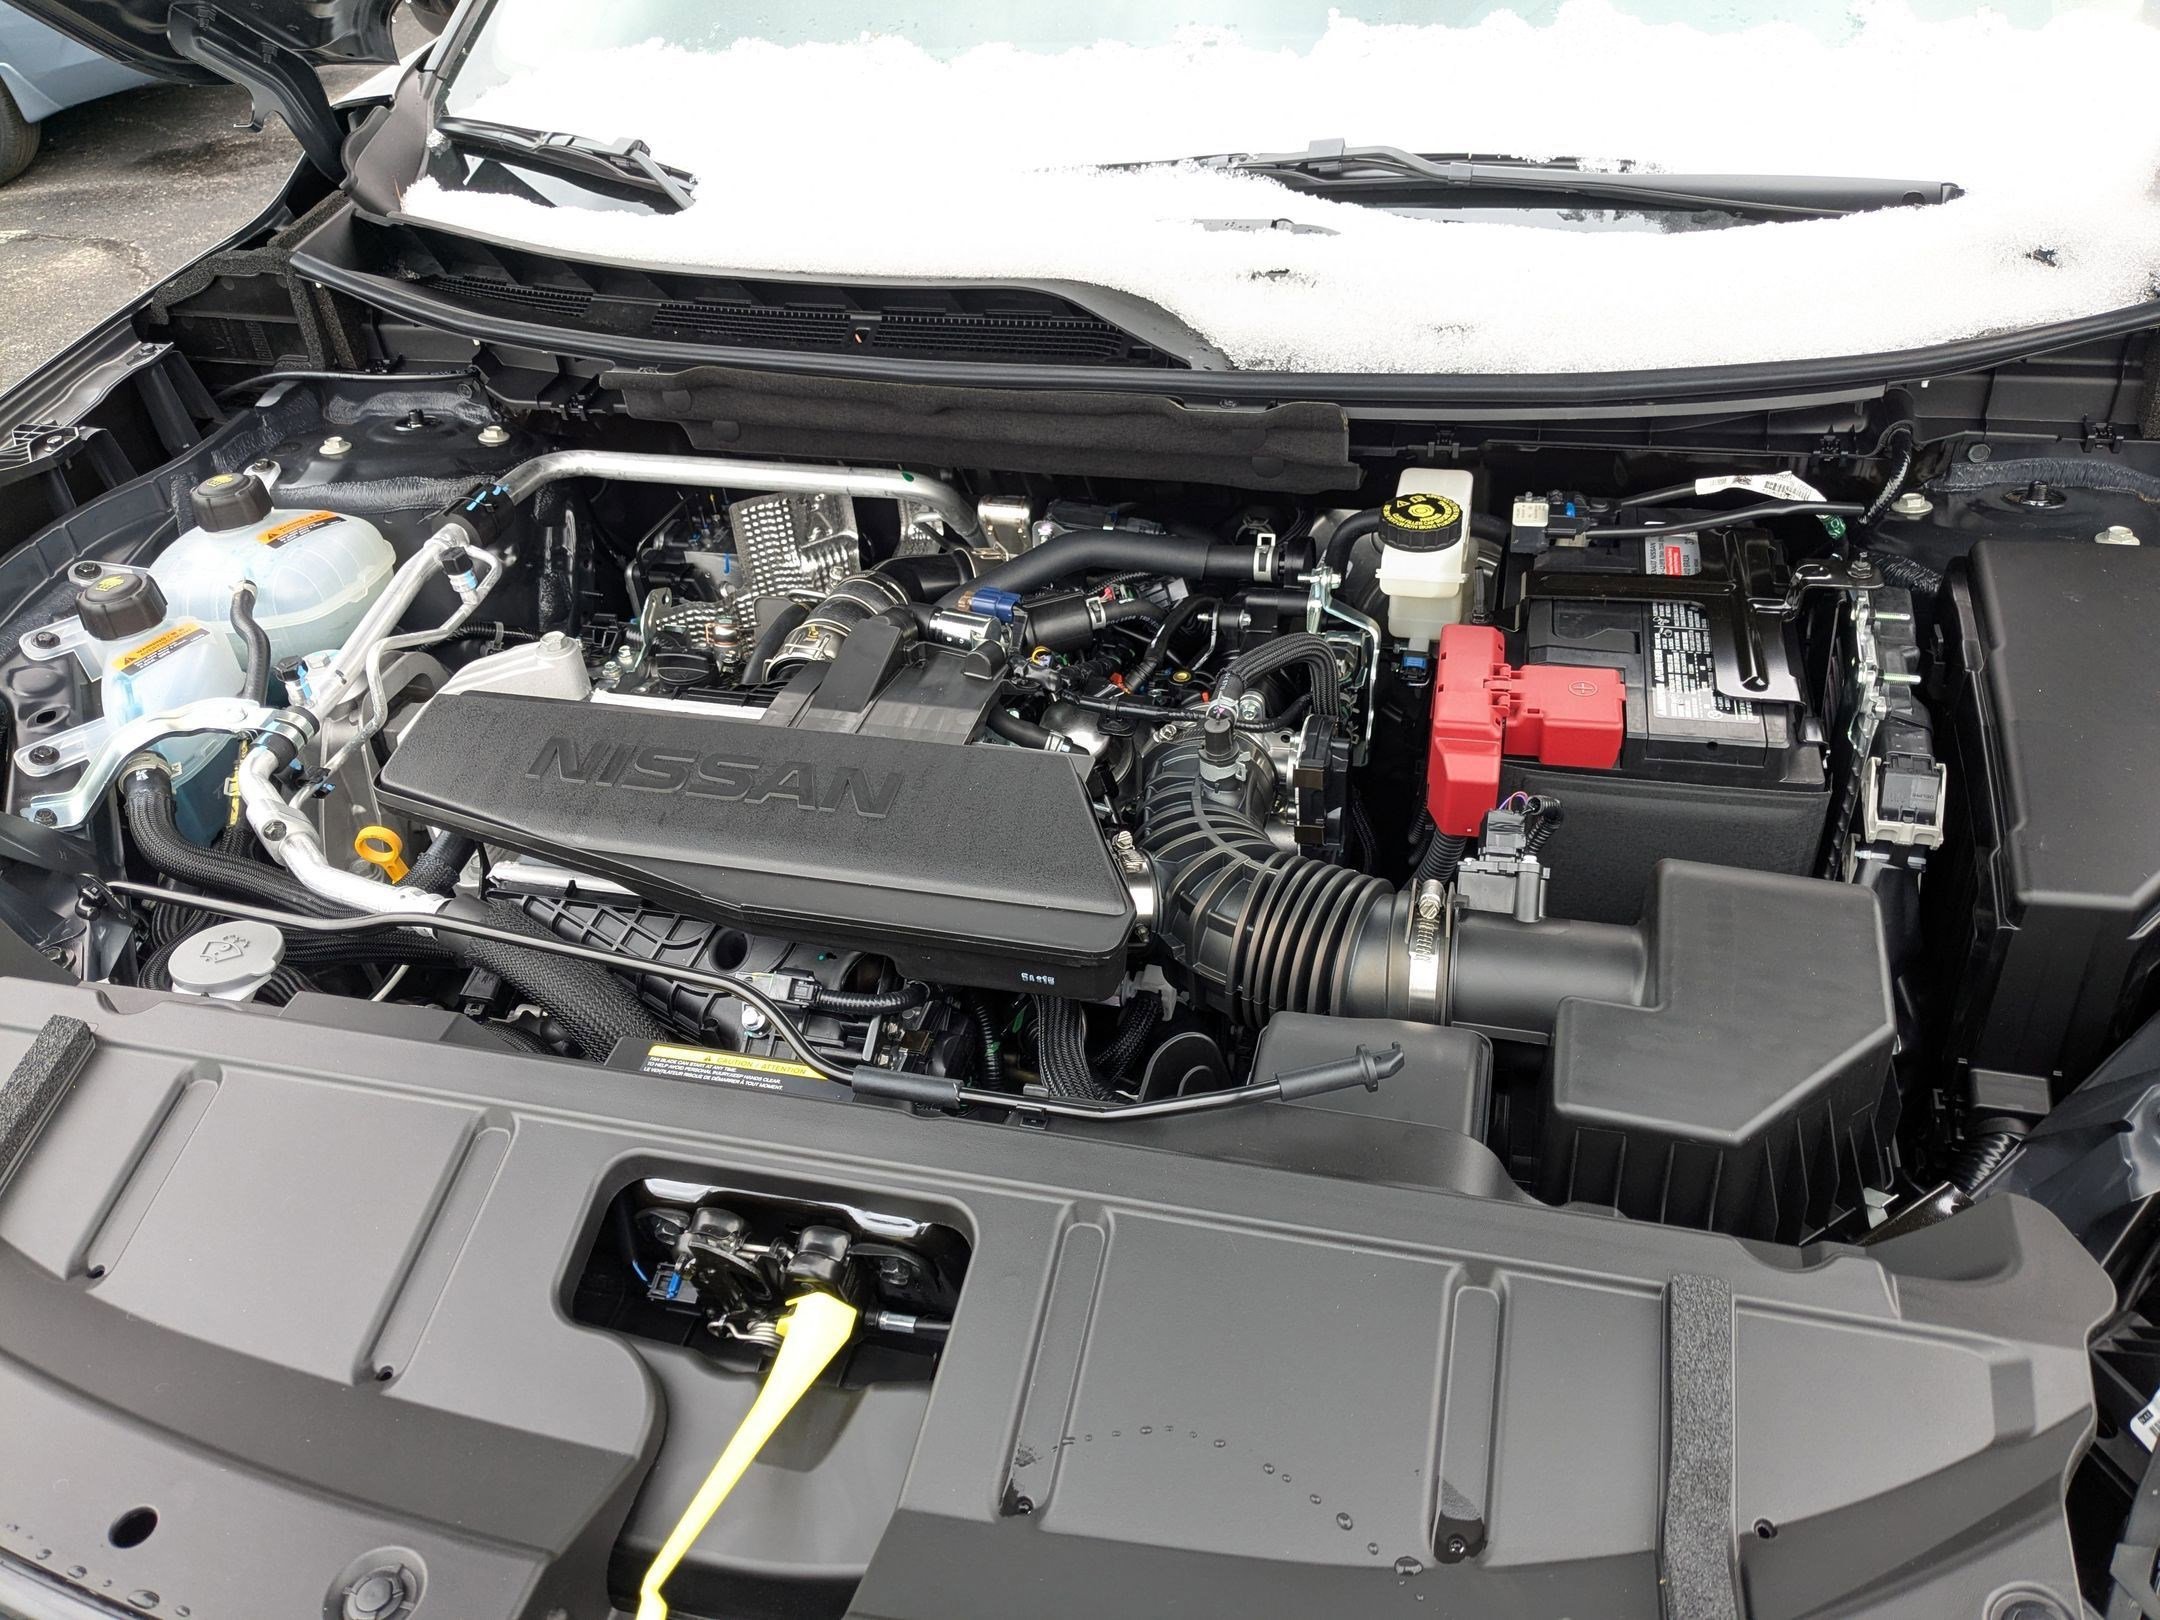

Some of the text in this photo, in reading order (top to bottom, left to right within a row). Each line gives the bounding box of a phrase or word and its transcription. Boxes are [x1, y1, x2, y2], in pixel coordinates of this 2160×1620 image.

[525, 735, 902, 819] NISSAN
[651, 1068, 683, 1076] VENTILATEUR
[717, 1058, 753, 1068] CAUTION
[761, 1064, 807, 1075] ATTENTION
